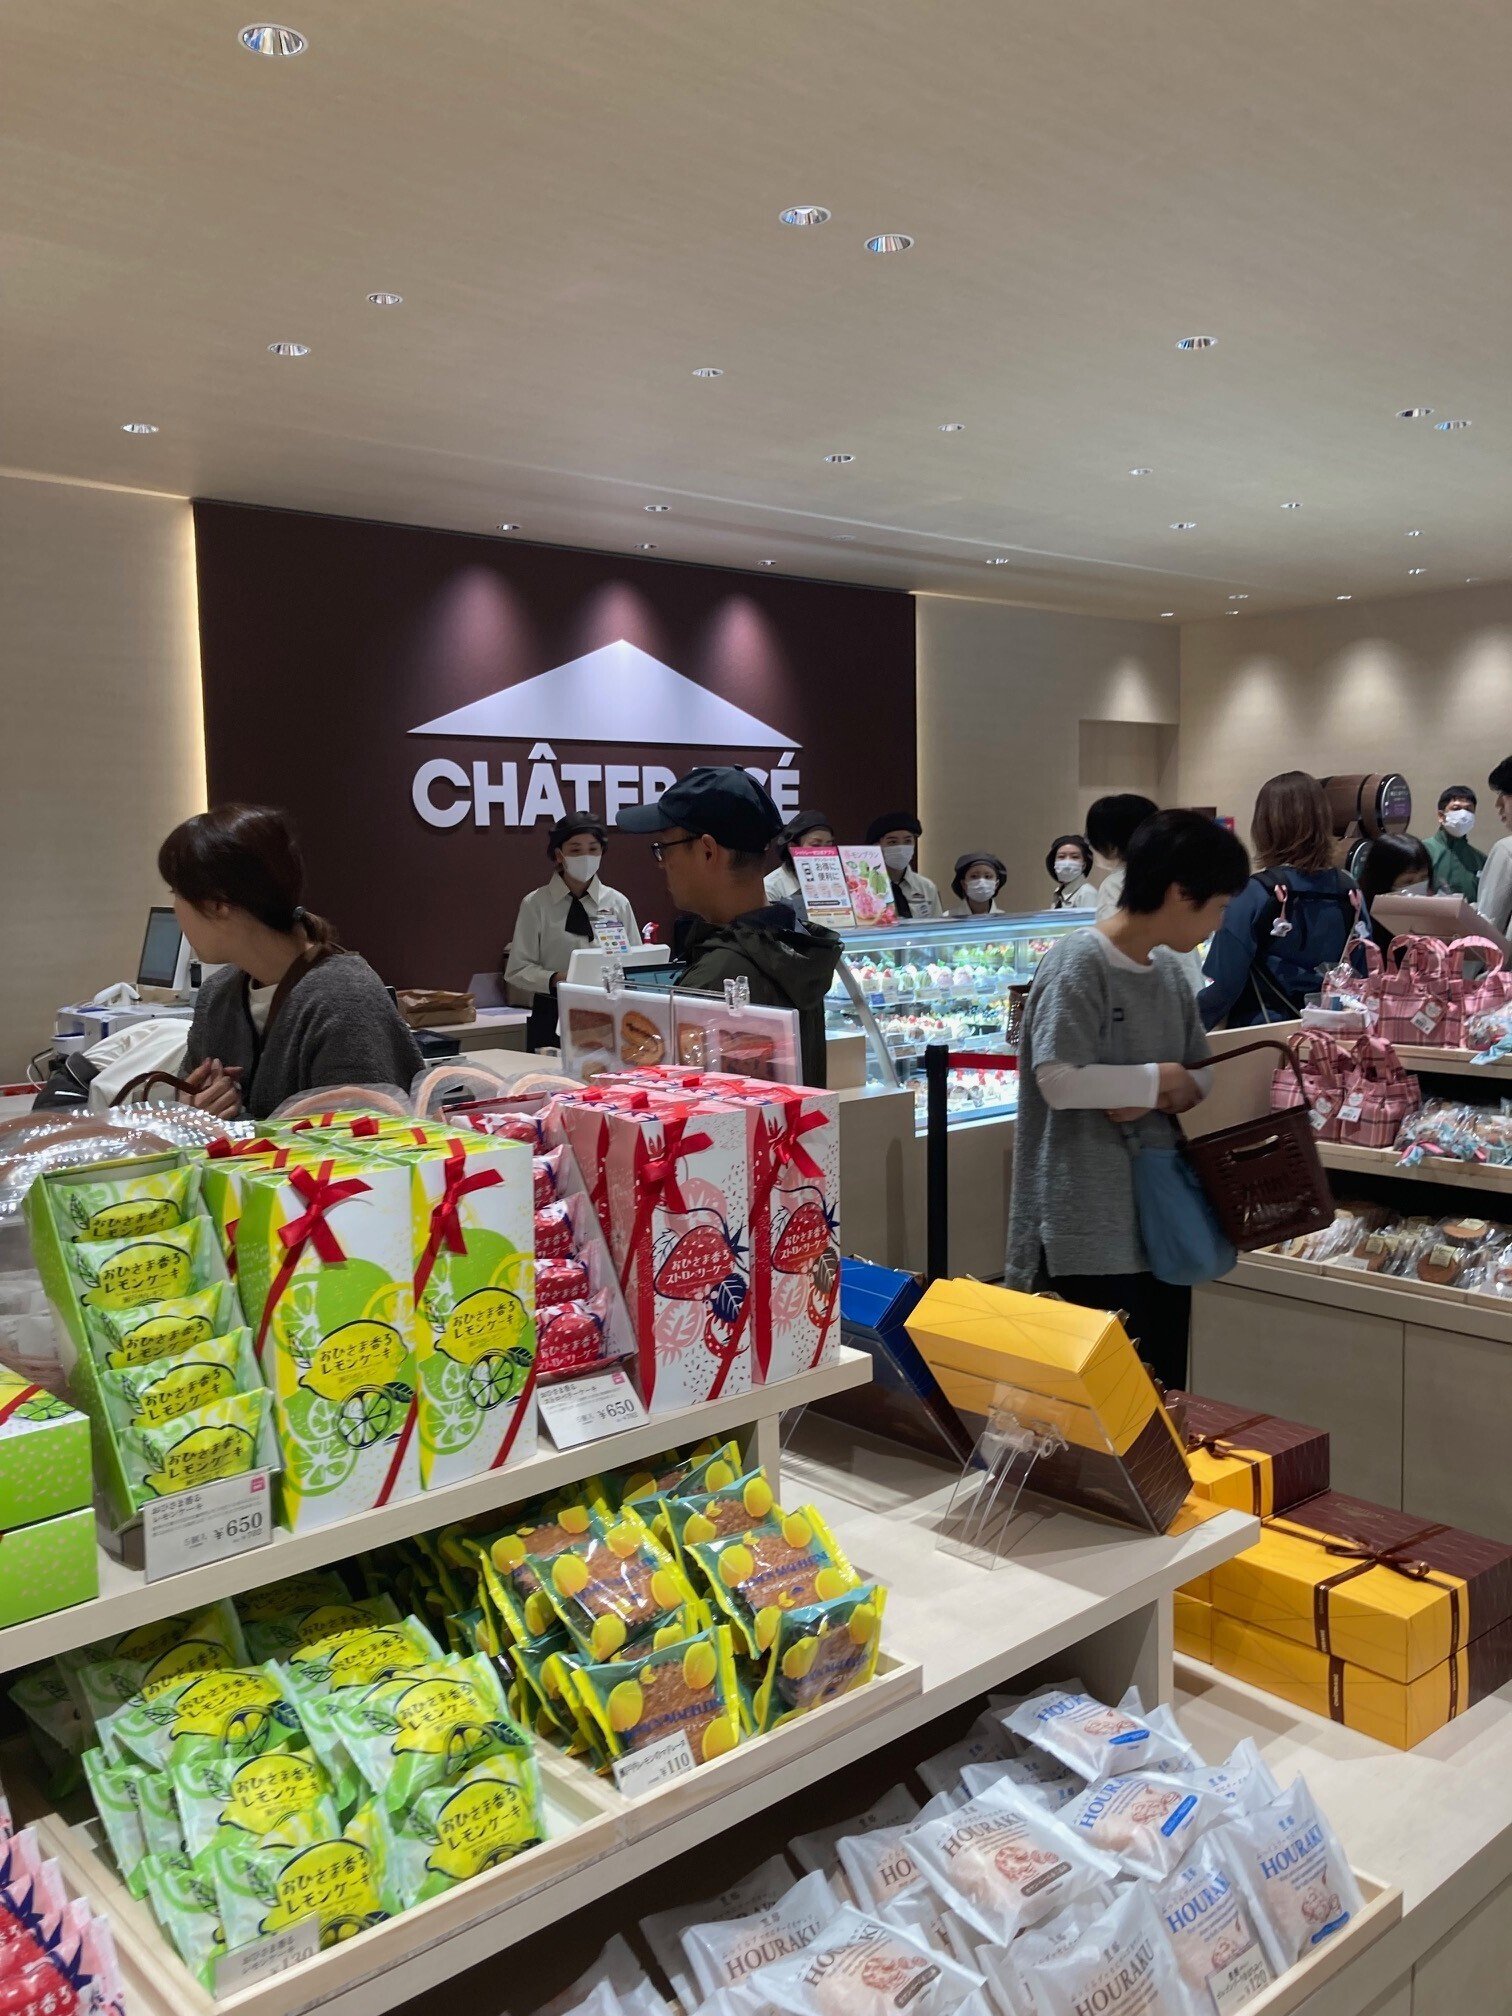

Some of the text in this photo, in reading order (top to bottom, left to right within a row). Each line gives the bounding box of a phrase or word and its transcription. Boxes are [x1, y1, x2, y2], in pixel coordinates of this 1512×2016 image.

[412, 743, 801, 829] CHÂTERÉ
[104, 1252, 181, 1280] おひさま香る
[105, 1268, 179, 1293] レモンケーキ
[453, 1300, 516, 1327] おひさま香る
[454, 1314, 514, 1339] レモンケーキ
[320, 1333, 393, 1362] おひさま香る
[321, 1347, 391, 1375] レモンケーキ
[214, 1512, 263, 1540] ¥650
[442, 1786, 518, 1834] おひさま香る
[447, 1806, 522, 1851] レモンケーキ
[281, 1851, 369, 1896] おひさま香る
[287, 1873, 370, 1914] レモンケーキ
